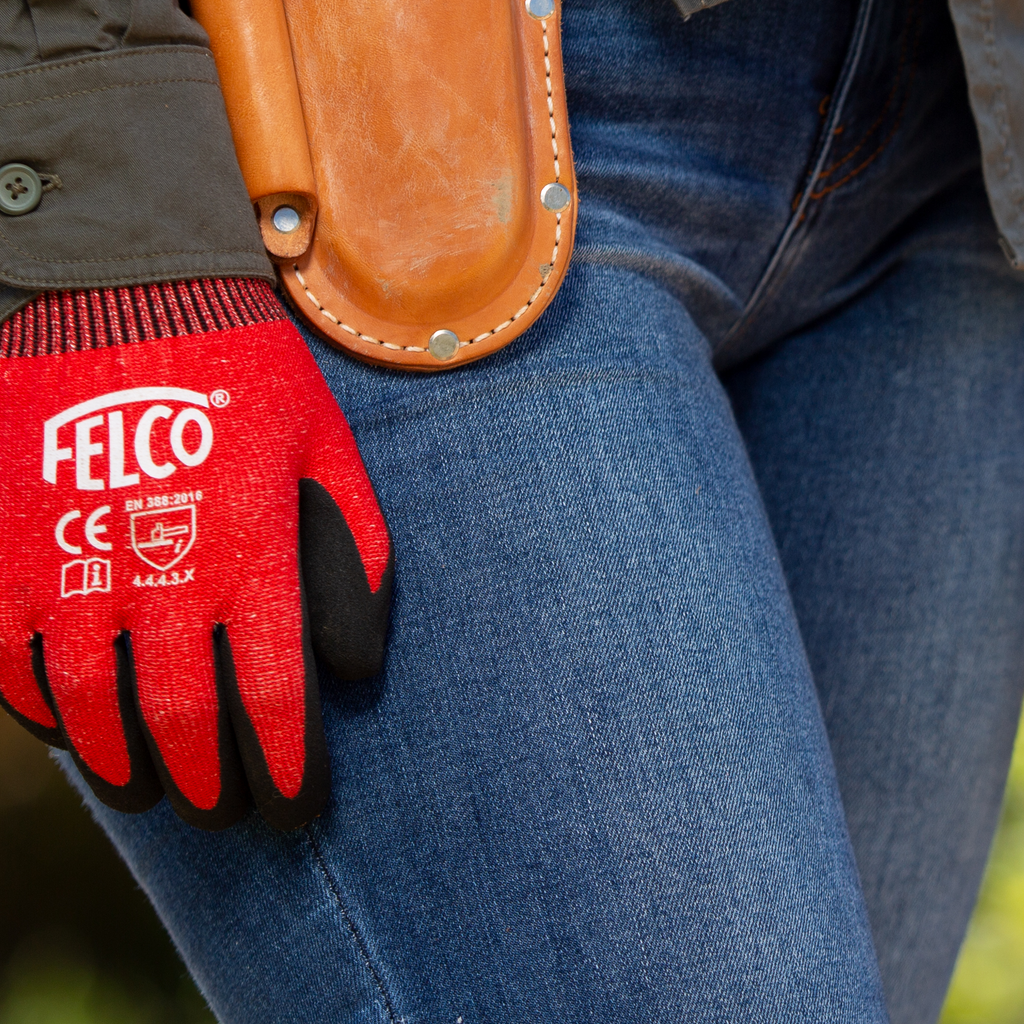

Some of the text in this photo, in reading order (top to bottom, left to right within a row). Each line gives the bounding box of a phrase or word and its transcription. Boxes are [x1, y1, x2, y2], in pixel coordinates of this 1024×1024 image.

[42, 386, 213, 491] FELCO
[125, 490, 203, 512] EN 388:2016
[55, 505, 113, 555] CE
